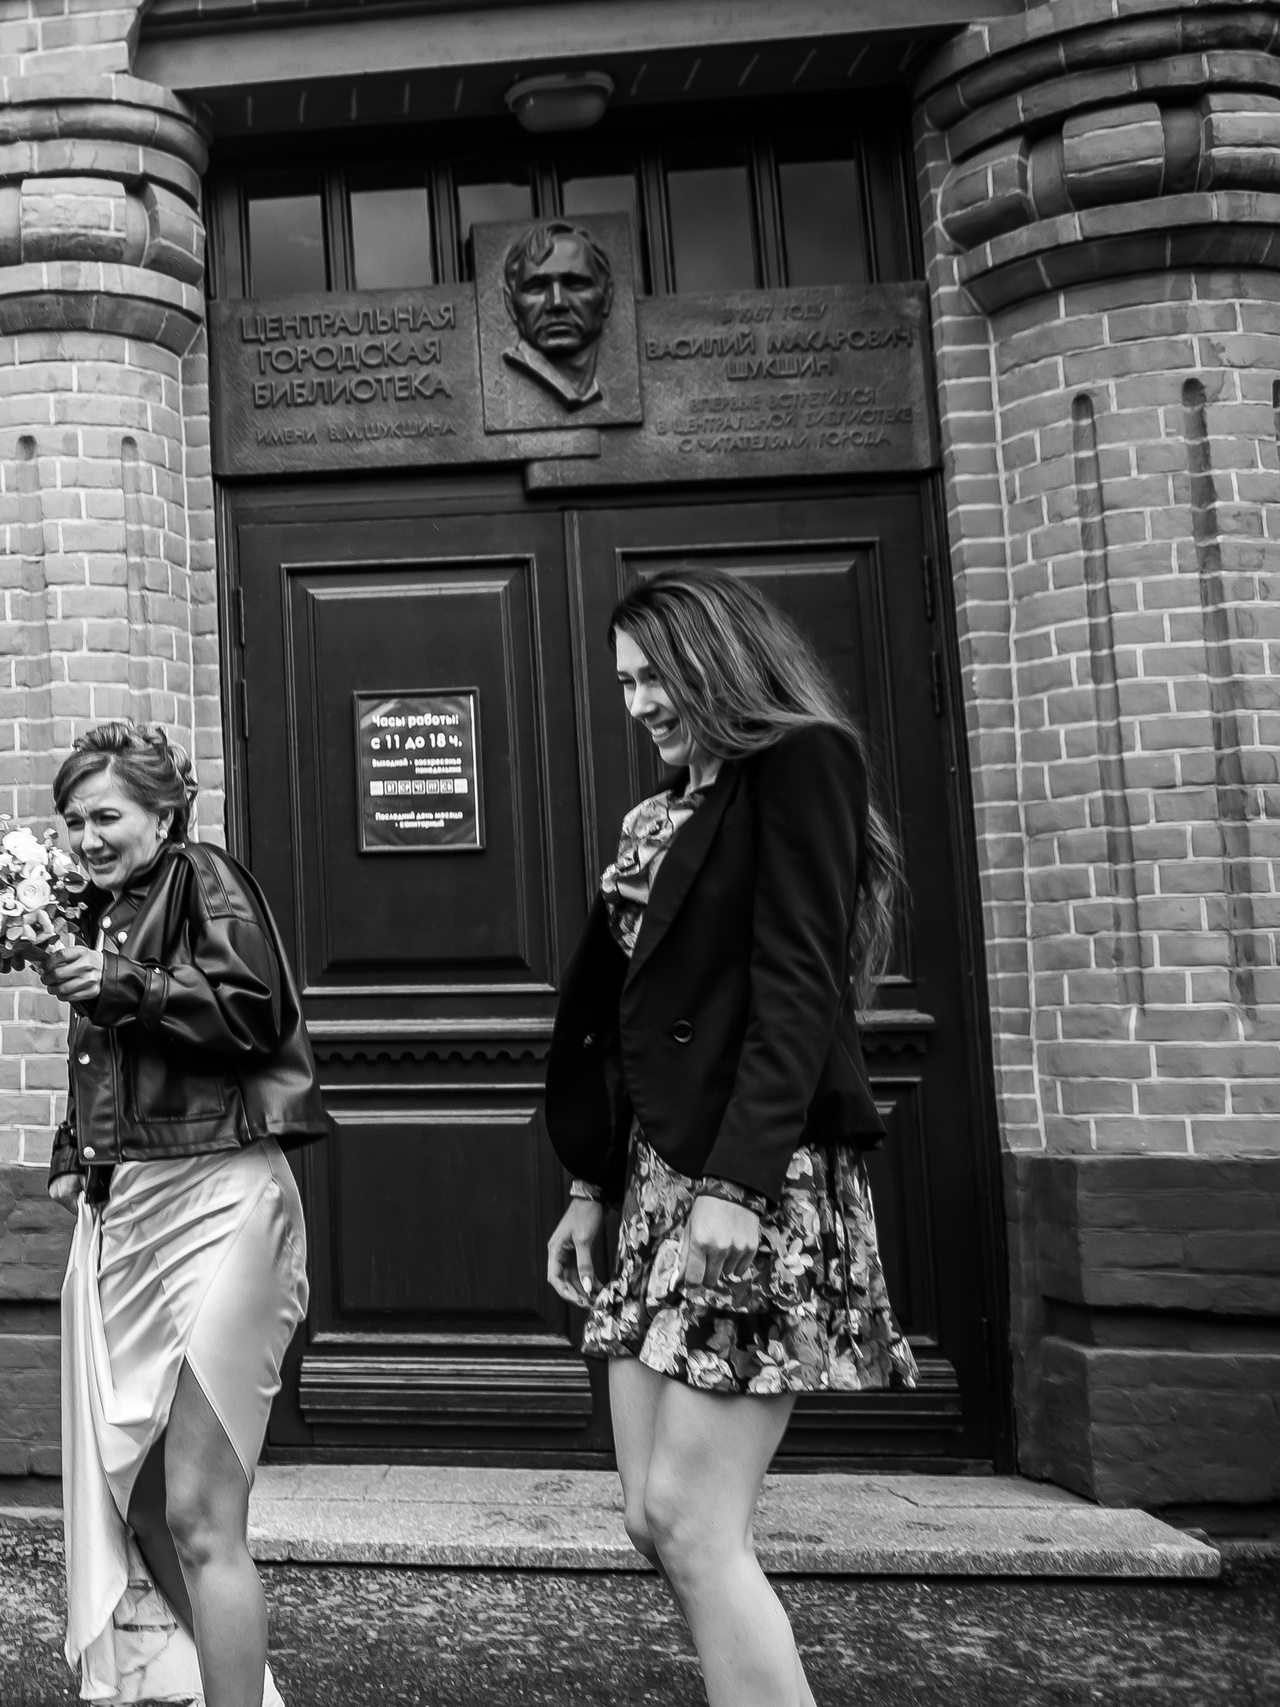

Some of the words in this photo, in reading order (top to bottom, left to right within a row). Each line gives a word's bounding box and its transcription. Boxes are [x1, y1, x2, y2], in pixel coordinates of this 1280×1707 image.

[241, 303, 456, 345] ЦЕНТРАЛЬНАЯ
[258, 338, 441, 374] ГОРОДСКАЯ
[644, 331, 757, 361] ВАСИЛИЙ
[767, 327, 914, 355] МАКАРОВИЧ
[726, 355, 833, 382] ШУКШИН
[253, 373, 452, 409] БИБЛИОТЕКА
[673, 412, 794, 435] ЦЕНТРАЛЬНОЙ
[805, 406, 913, 428] БИБЛИОТЕКЕ
[256, 427, 318, 446] ИМЕНИ
[698, 434, 807, 453] ЧИТАТЕЛЯМИ
[818, 429, 892, 449] ГОРОДА
[372, 714, 405, 728] Часы
[385, 734, 400, 749] 11
[405, 736, 425, 750] до
[430, 733, 446, 748] 18
